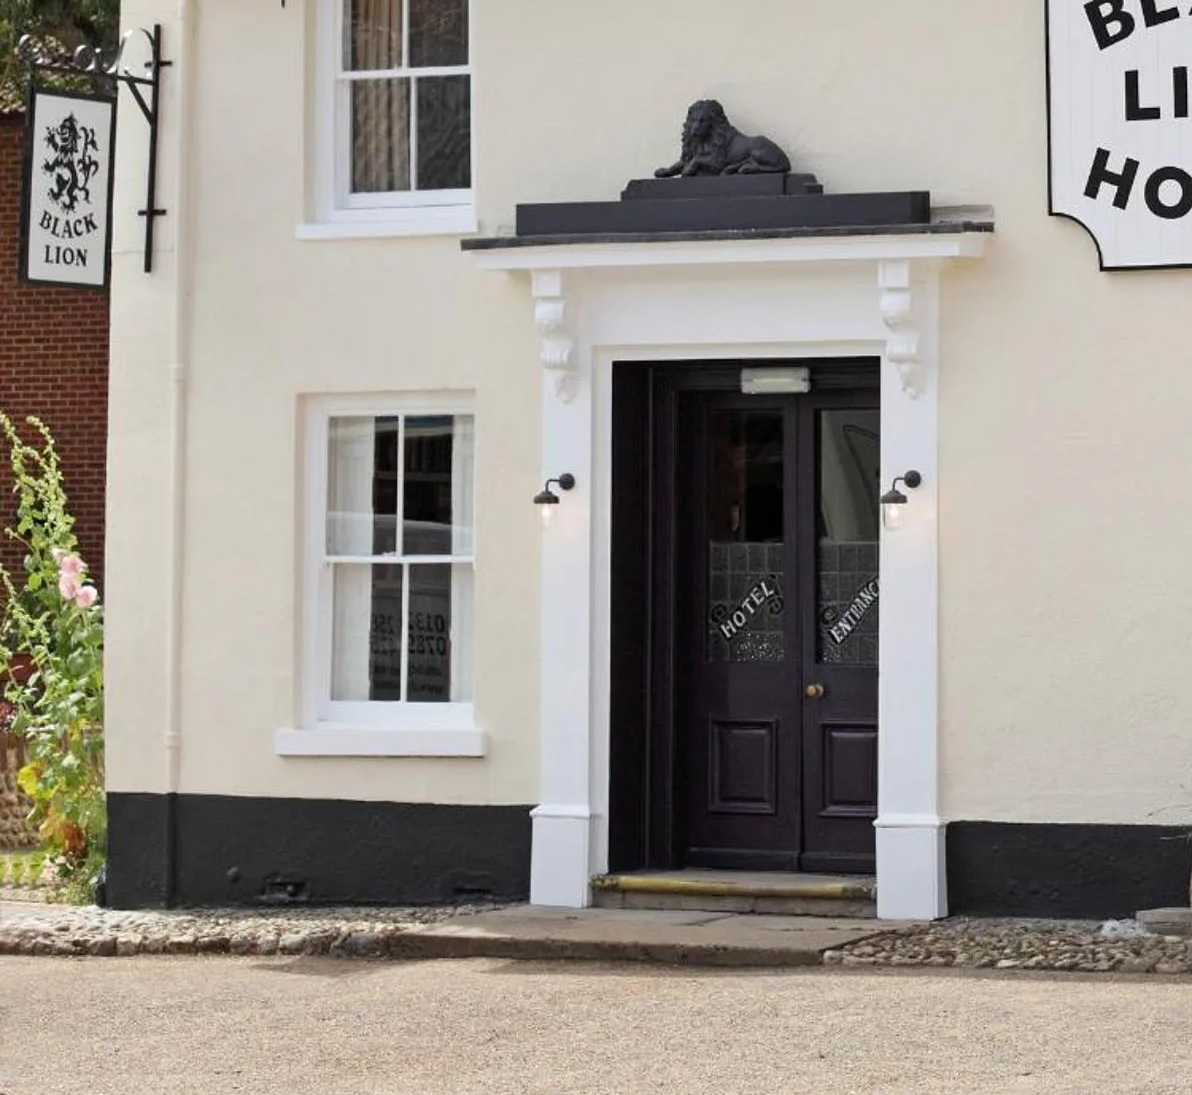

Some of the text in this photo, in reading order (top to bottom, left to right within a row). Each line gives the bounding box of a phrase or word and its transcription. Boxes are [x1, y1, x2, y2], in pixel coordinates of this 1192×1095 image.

[38, 210, 99, 239] BLACK
[44, 244, 88, 267] LION
[719, 580, 776, 639] HOTEL
[829, 578, 879, 644] ENTRANC
